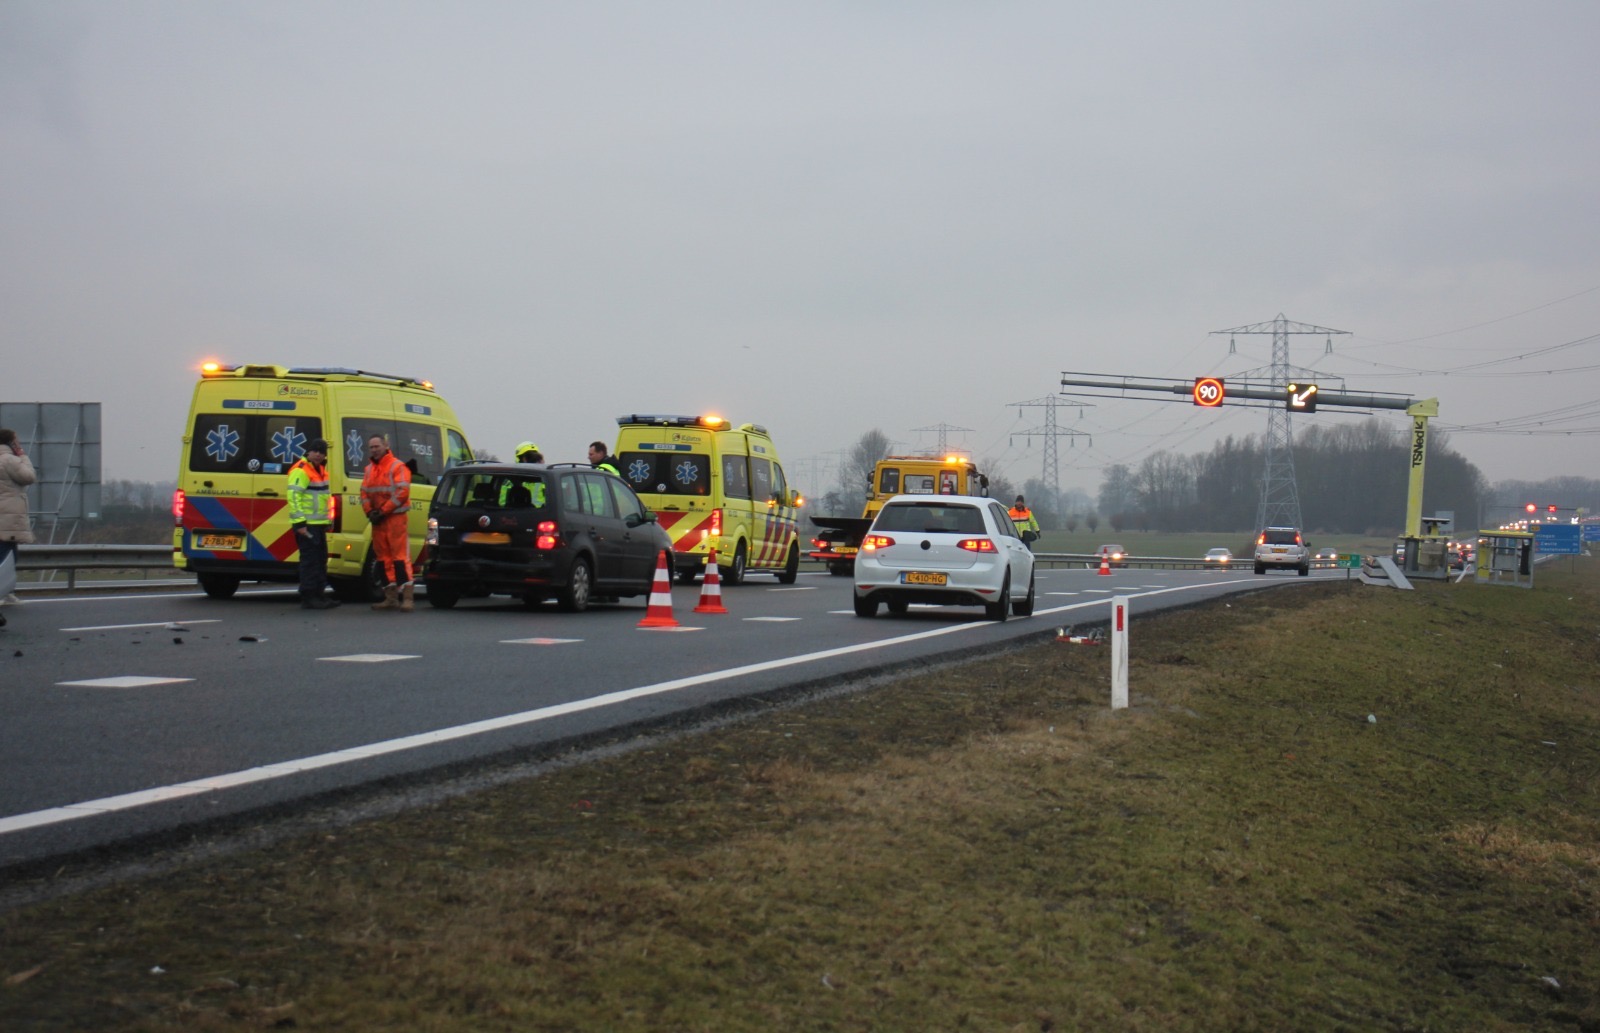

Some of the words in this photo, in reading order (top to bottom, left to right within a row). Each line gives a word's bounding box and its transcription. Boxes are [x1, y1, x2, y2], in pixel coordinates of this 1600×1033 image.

[1200, 385, 1217, 399] 90
[1412, 431, 1424, 468] TSNed
[204, 537, 239, 546] Z-783-NP
[907, 574, 943, 583] L-410-HG
